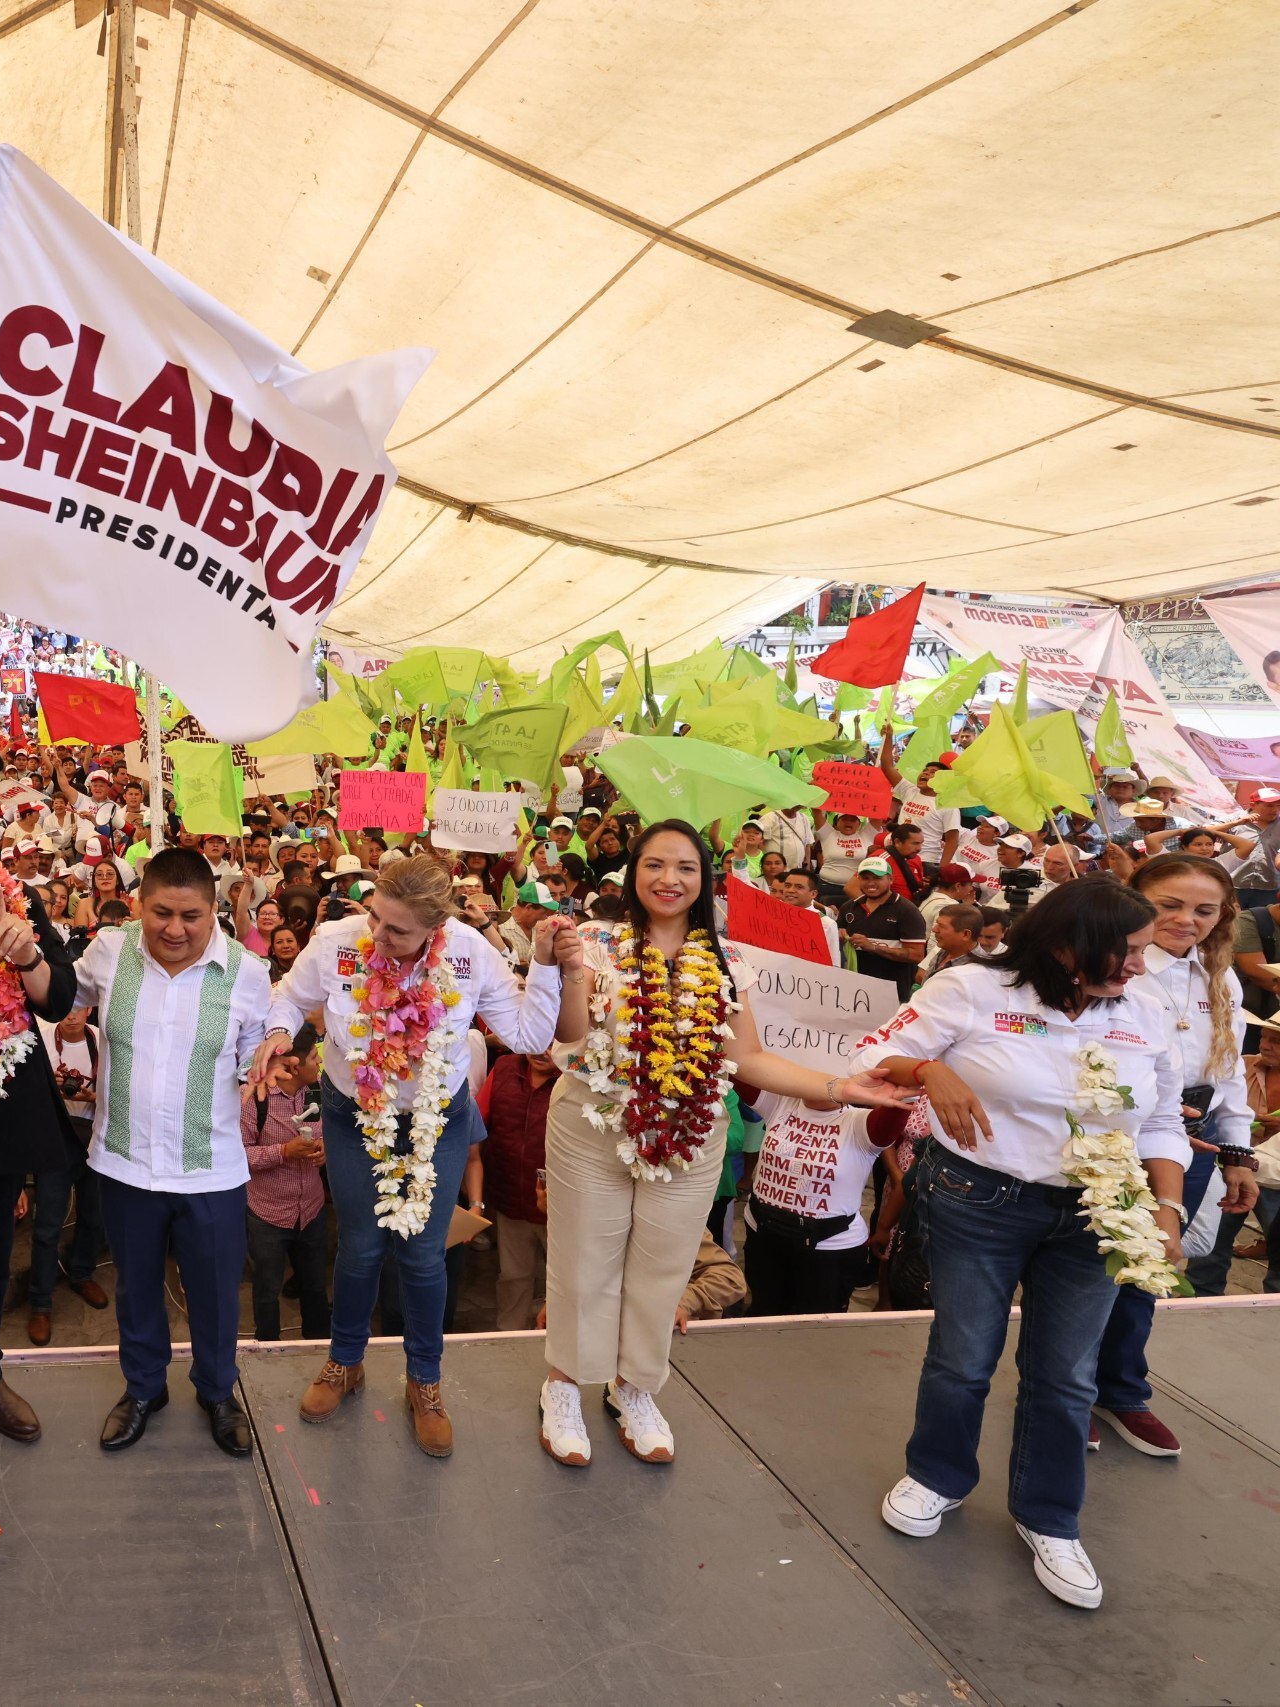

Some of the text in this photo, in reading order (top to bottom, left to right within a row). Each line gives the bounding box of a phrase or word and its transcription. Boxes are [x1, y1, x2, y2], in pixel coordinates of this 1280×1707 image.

[55, 496, 276, 631] PRESIDENTA
[985, 603, 1017, 612] HACIENDO
[963, 607, 1034, 627] morena
[1036, 618, 1048, 628] PT
[1026, 645, 1041, 653] DE
[1042, 646, 1068, 655] JUNIO
[1024, 652, 1083, 666] VOTA
[2, 678, 23, 692] PT
[68, 694, 101, 715] PT
[668, 784, 683, 797] SE
[447, 796, 509, 813] JONOTLA
[436, 819, 500, 835] PRESENTE
[337, 950, 361, 960] mor
[340, 966, 353, 976] PT
[753, 966, 871, 1014] ONOTLA
[995, 1012, 1047, 1026] morena
[764, 1024, 851, 1058] ESENTE
[1104, 1035, 1148, 1045] MARTINEZ
[1110, 1030, 1141, 1040] ESTHER
[765, 1135, 838, 1165] ARMENTA
[761, 1150, 835, 1181] ARMENTA
[760, 1165, 831, 1196] ARMENTA
[755, 1180, 828, 1212] ARMENTA
